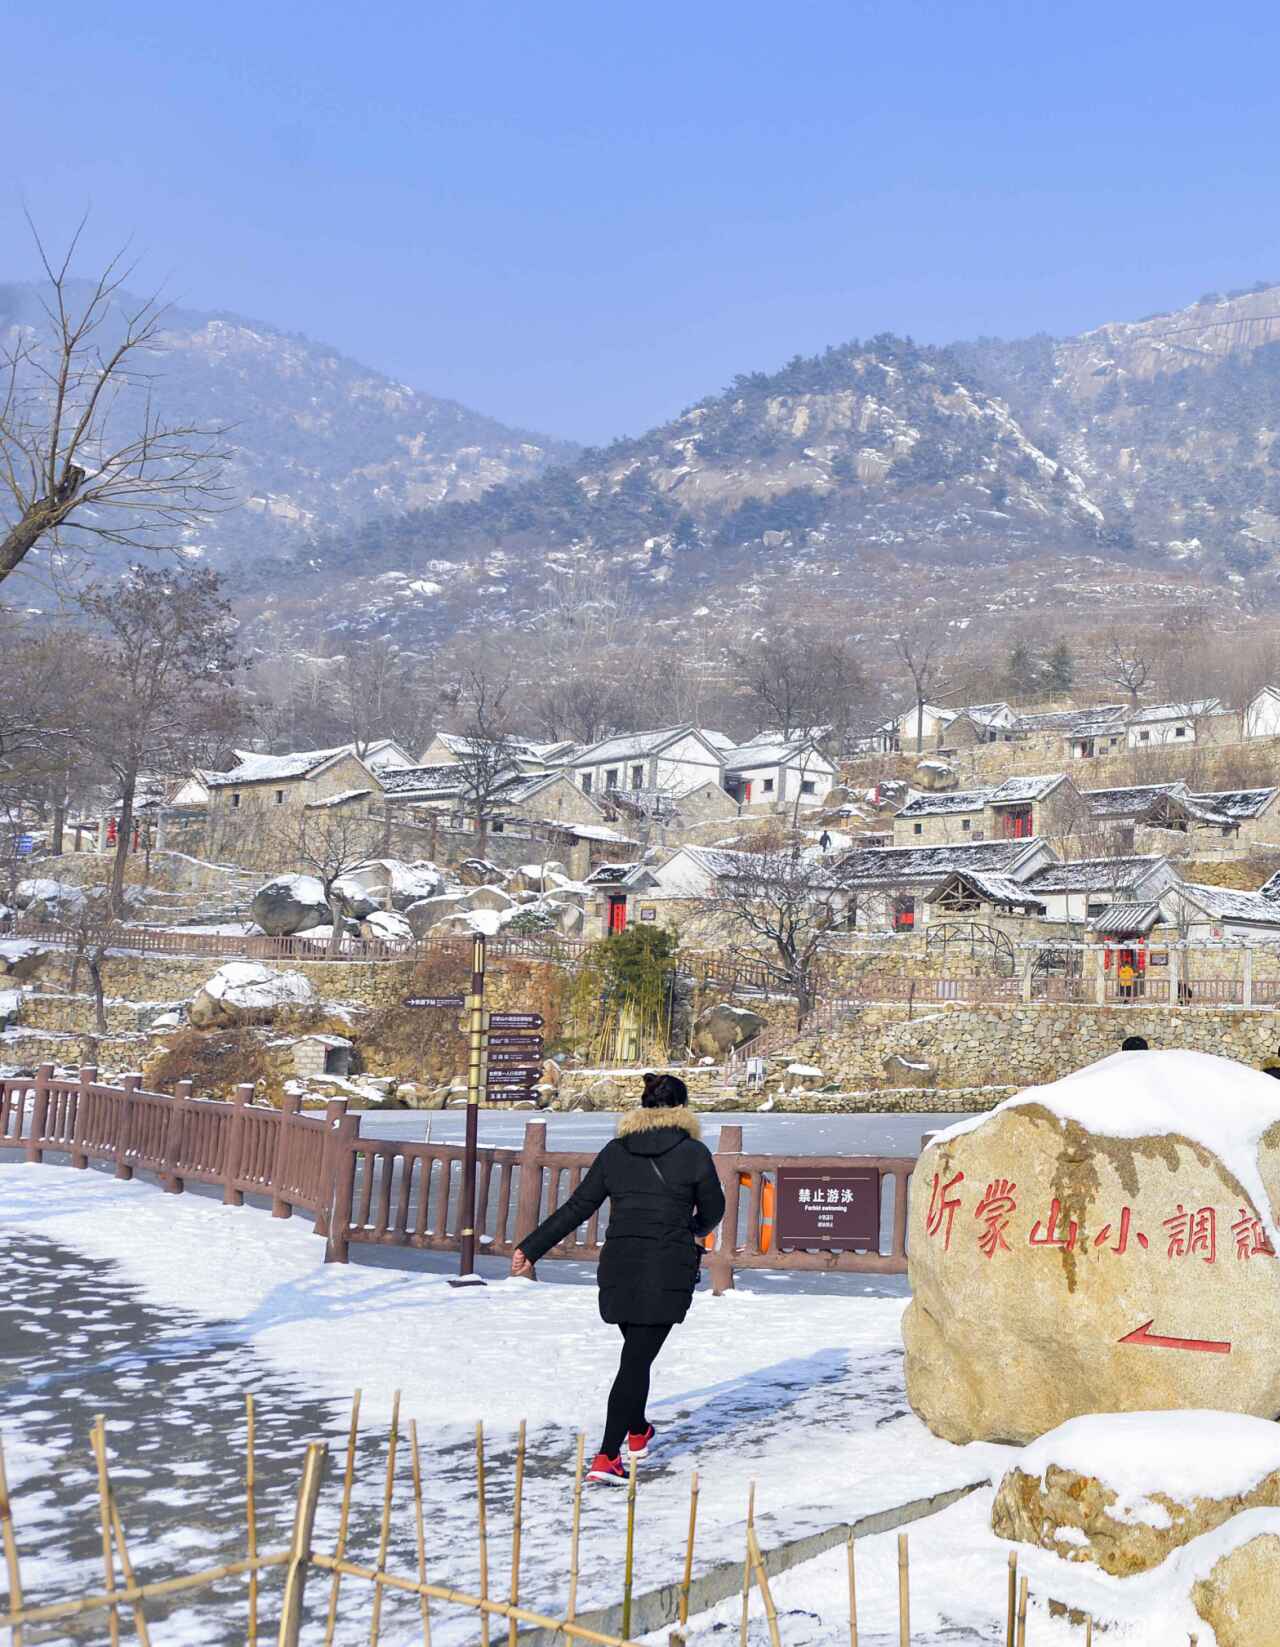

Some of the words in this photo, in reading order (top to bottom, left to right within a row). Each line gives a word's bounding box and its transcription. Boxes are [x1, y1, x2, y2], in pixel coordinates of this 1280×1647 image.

[798, 1188, 854, 1203] 禁止游泳
[822, 1205, 848, 1213] swimming
